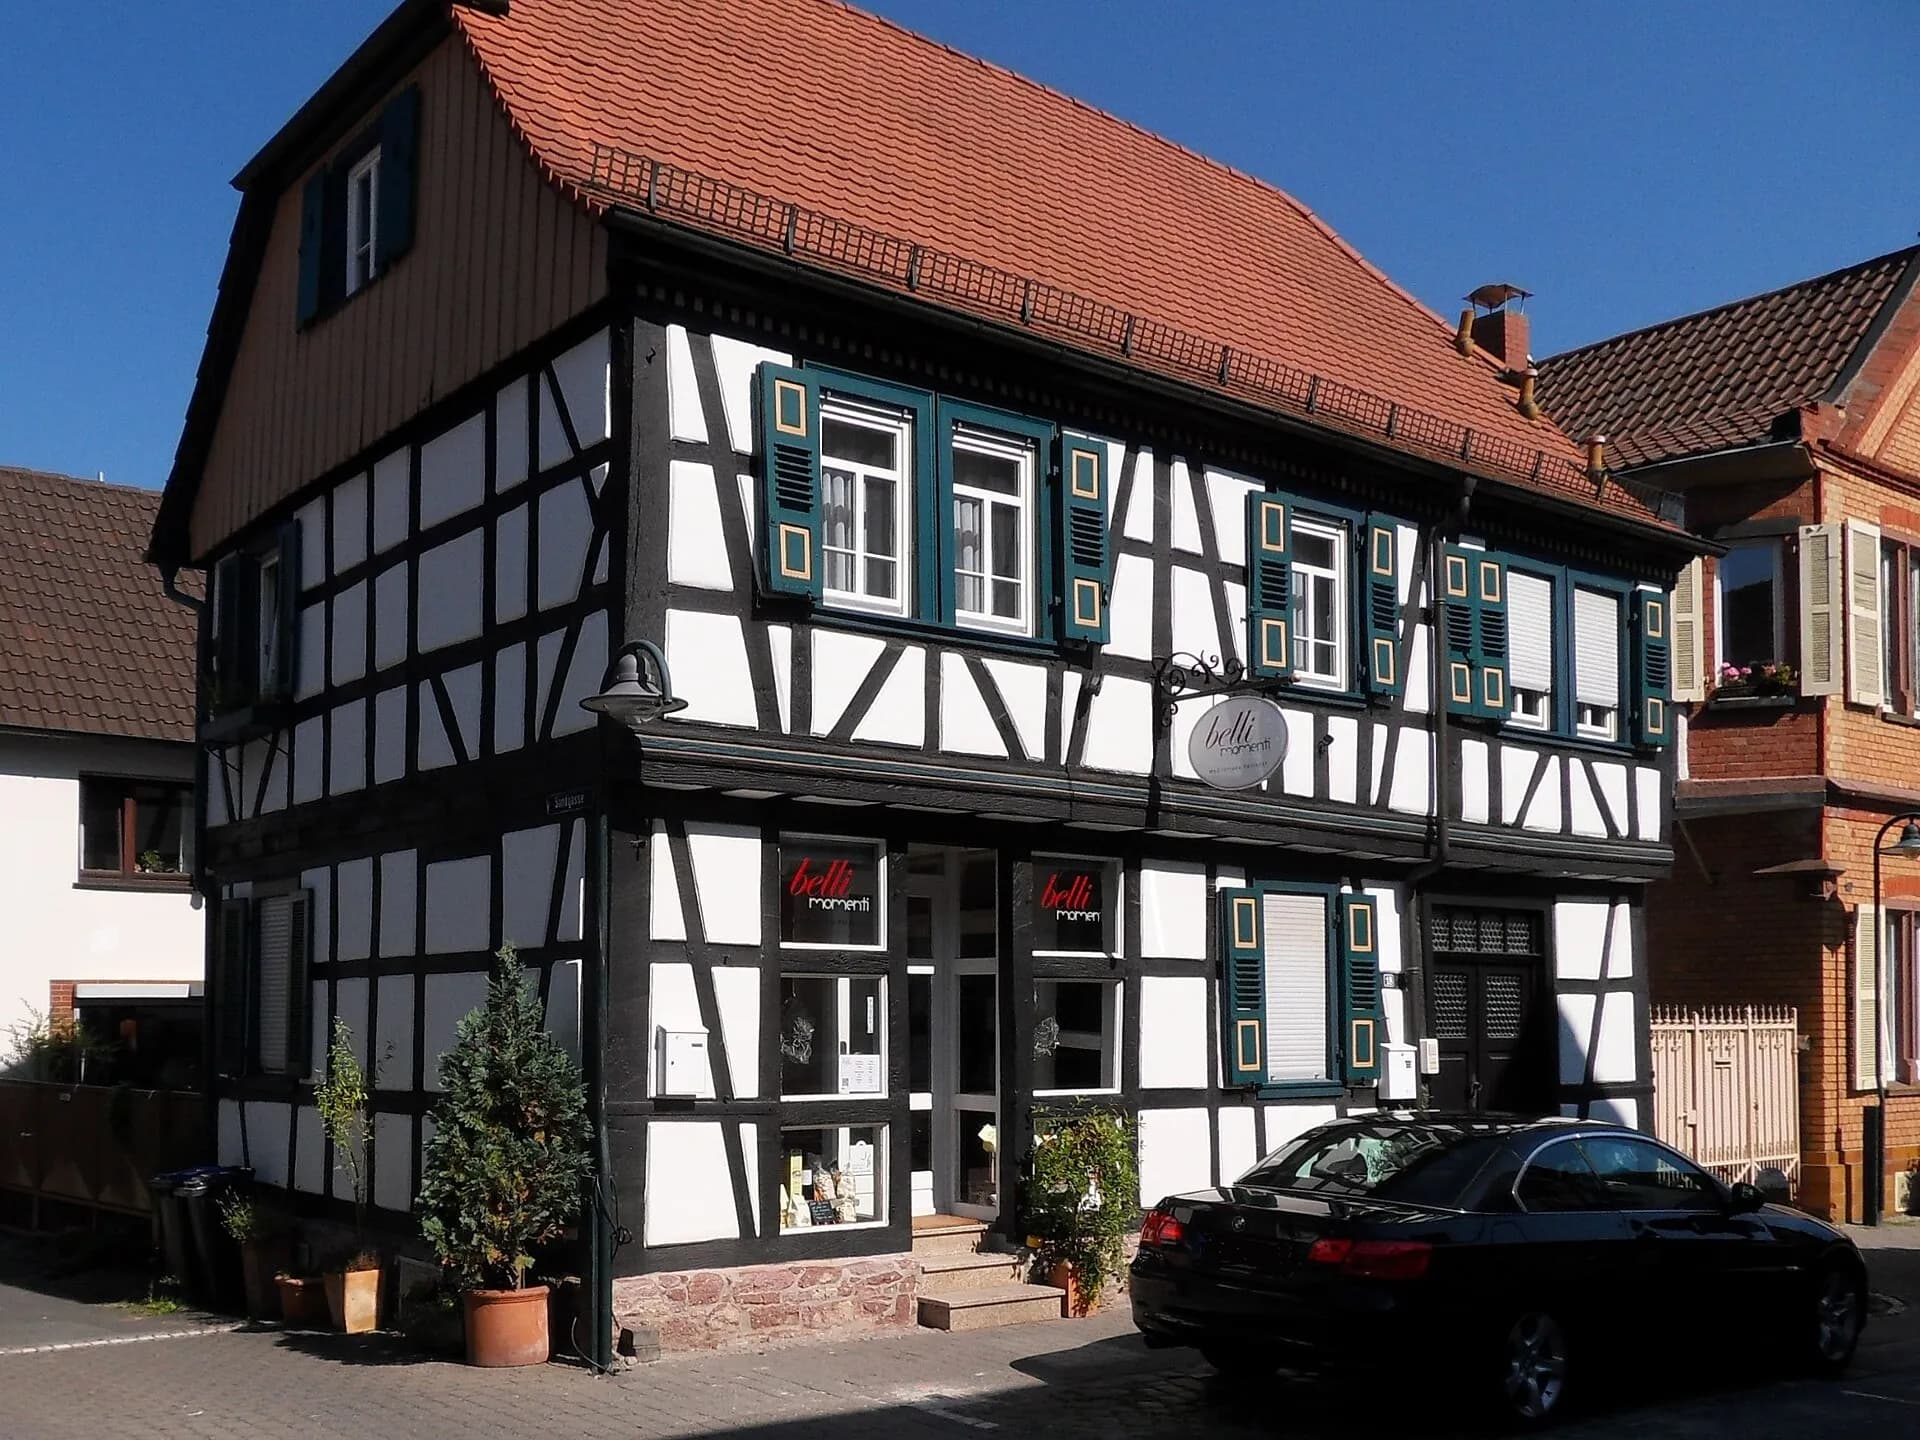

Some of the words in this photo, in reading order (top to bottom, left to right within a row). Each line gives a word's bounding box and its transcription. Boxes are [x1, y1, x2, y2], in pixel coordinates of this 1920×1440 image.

[1206, 710, 1255, 749] belli
[1220, 738, 1271, 756] momenti
[789, 857, 853, 897] belli
[808, 896, 870, 912] momenti
[1042, 873, 1093, 910] belli
[1056, 910, 1100, 922] momen
